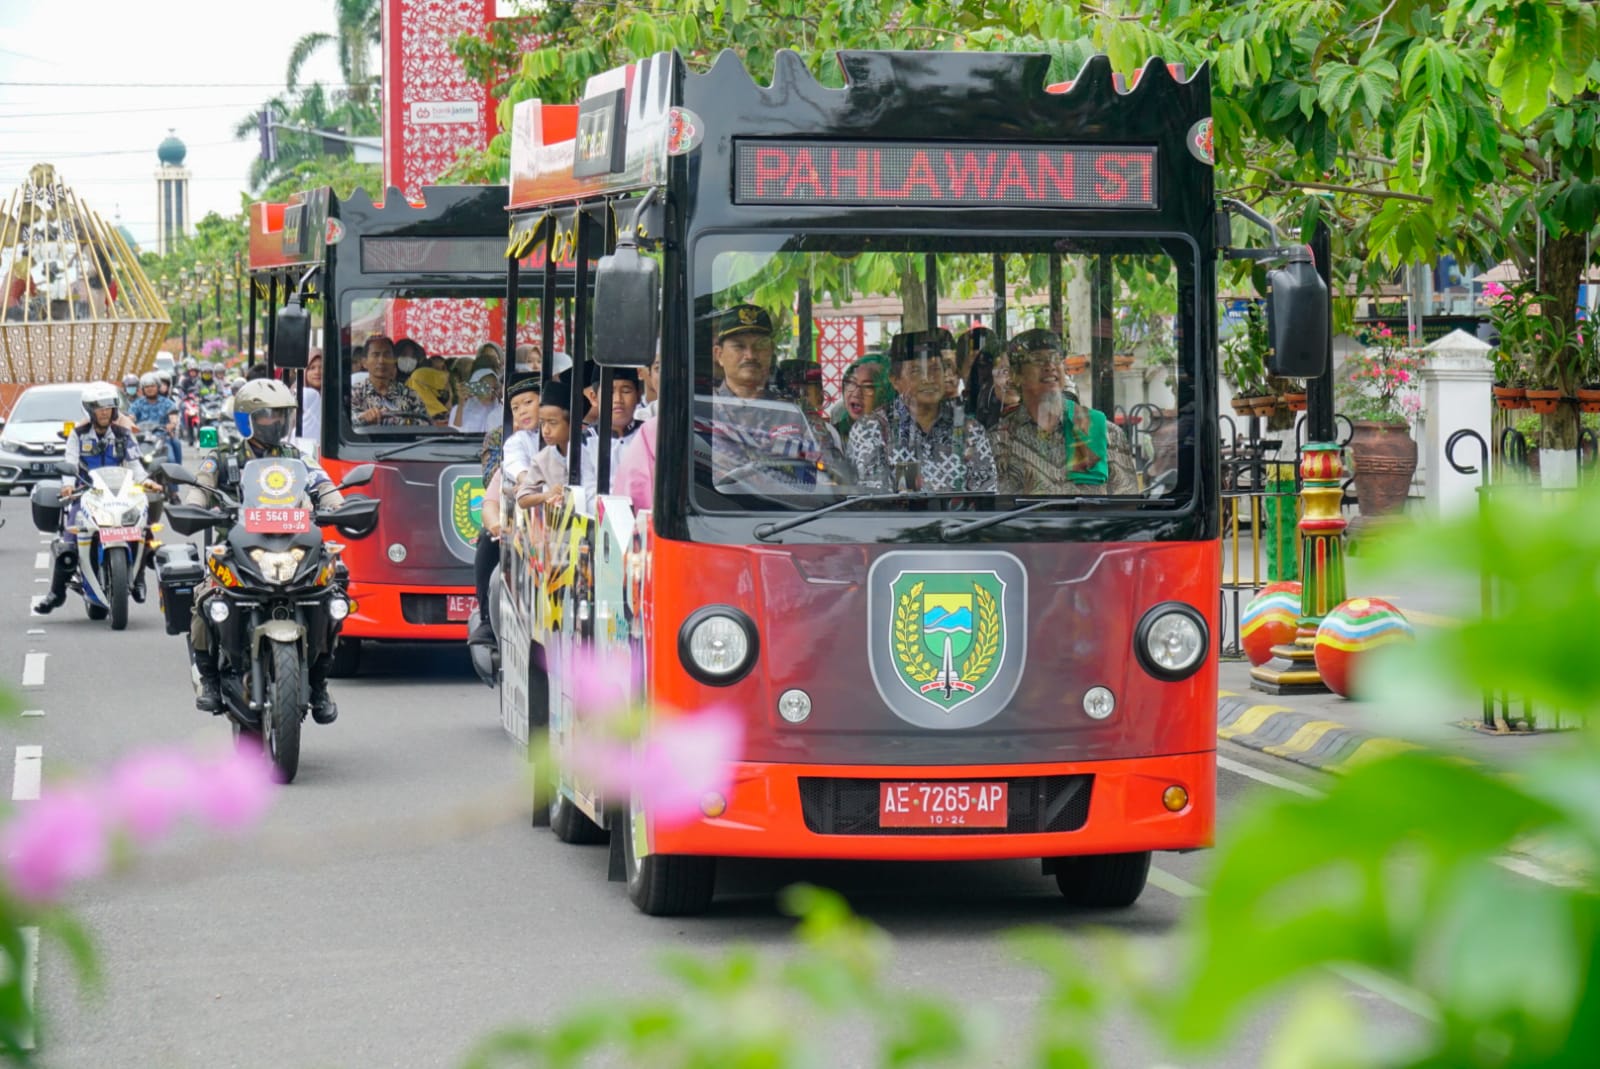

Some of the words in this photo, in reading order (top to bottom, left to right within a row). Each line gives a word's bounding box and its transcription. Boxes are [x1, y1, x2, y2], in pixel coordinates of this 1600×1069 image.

[754, 148, 1075, 200] PAHLAWAN
[249, 511, 261, 521] AE
[450, 597, 464, 611] AE
[884, 787, 910, 813] AE
[919, 786, 970, 812] 7265
[977, 785, 1003, 812] AP
